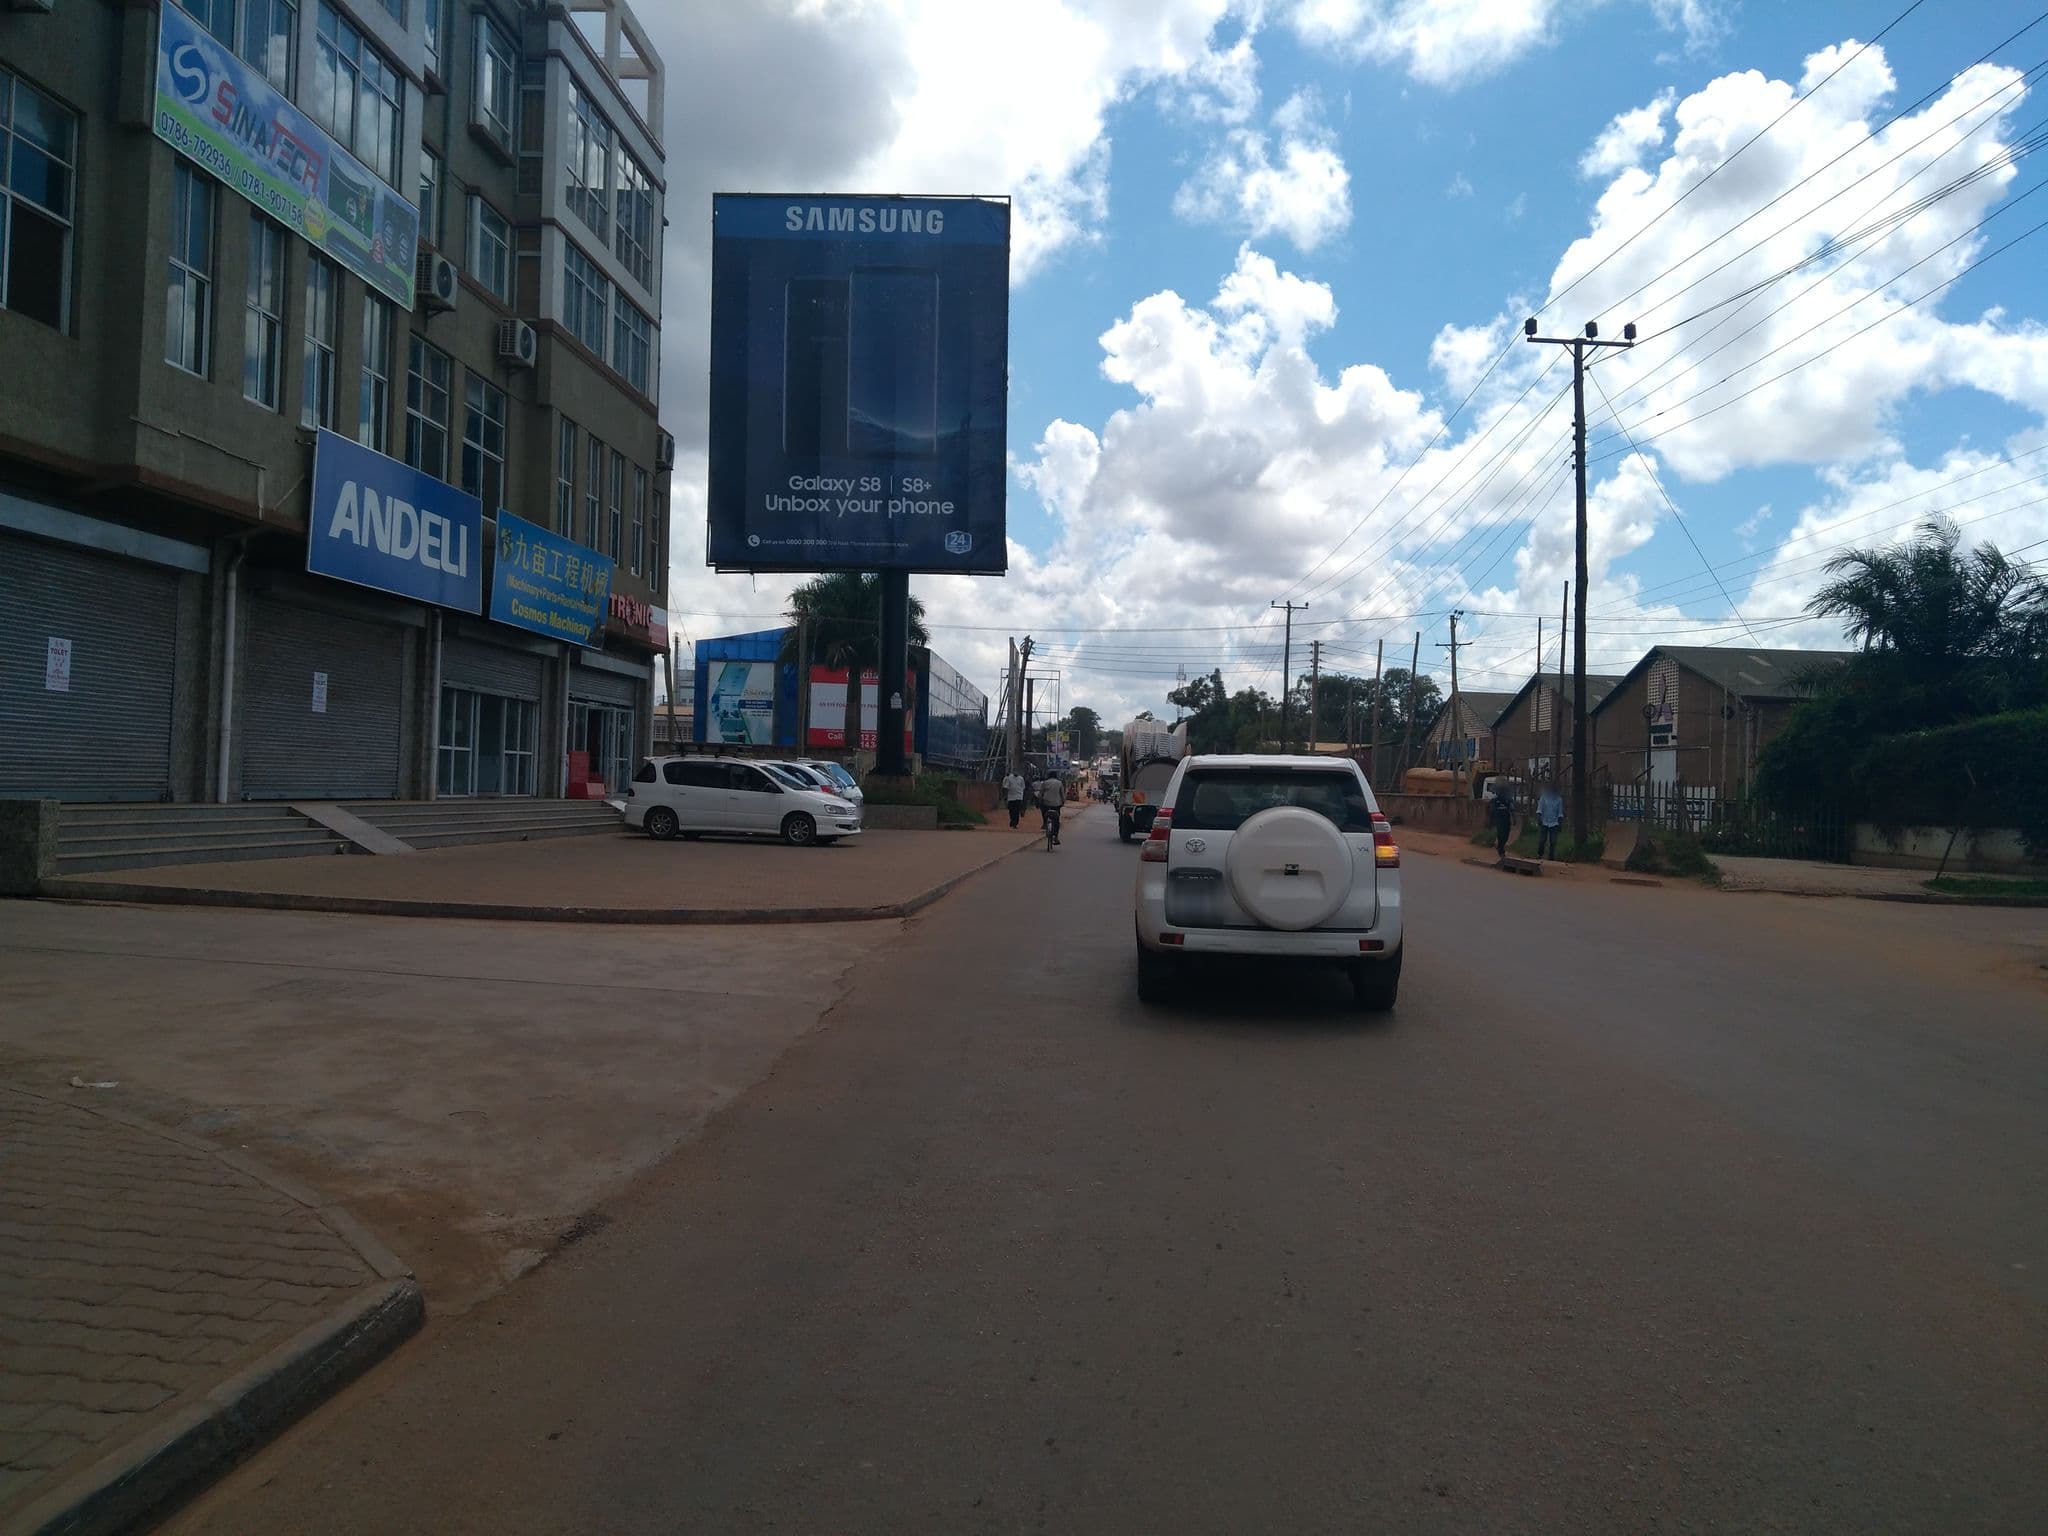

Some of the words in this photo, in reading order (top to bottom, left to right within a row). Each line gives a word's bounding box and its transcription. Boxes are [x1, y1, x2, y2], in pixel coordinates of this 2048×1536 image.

[785, 205, 944, 235] SAMSUNG
[788, 474, 855, 497] Galaxy
[859, 476, 881, 492] S8
[901, 477, 932, 493] S8+
[764, 493, 831, 512] Unbox
[836, 497, 883, 518] your
[887, 497, 955, 519] phone
[328, 480, 467, 578] ANDELI
[949, 534, 966, 546] 24
[511, 597, 548, 625] Cosmos
[827, 732, 843, 741] Call
